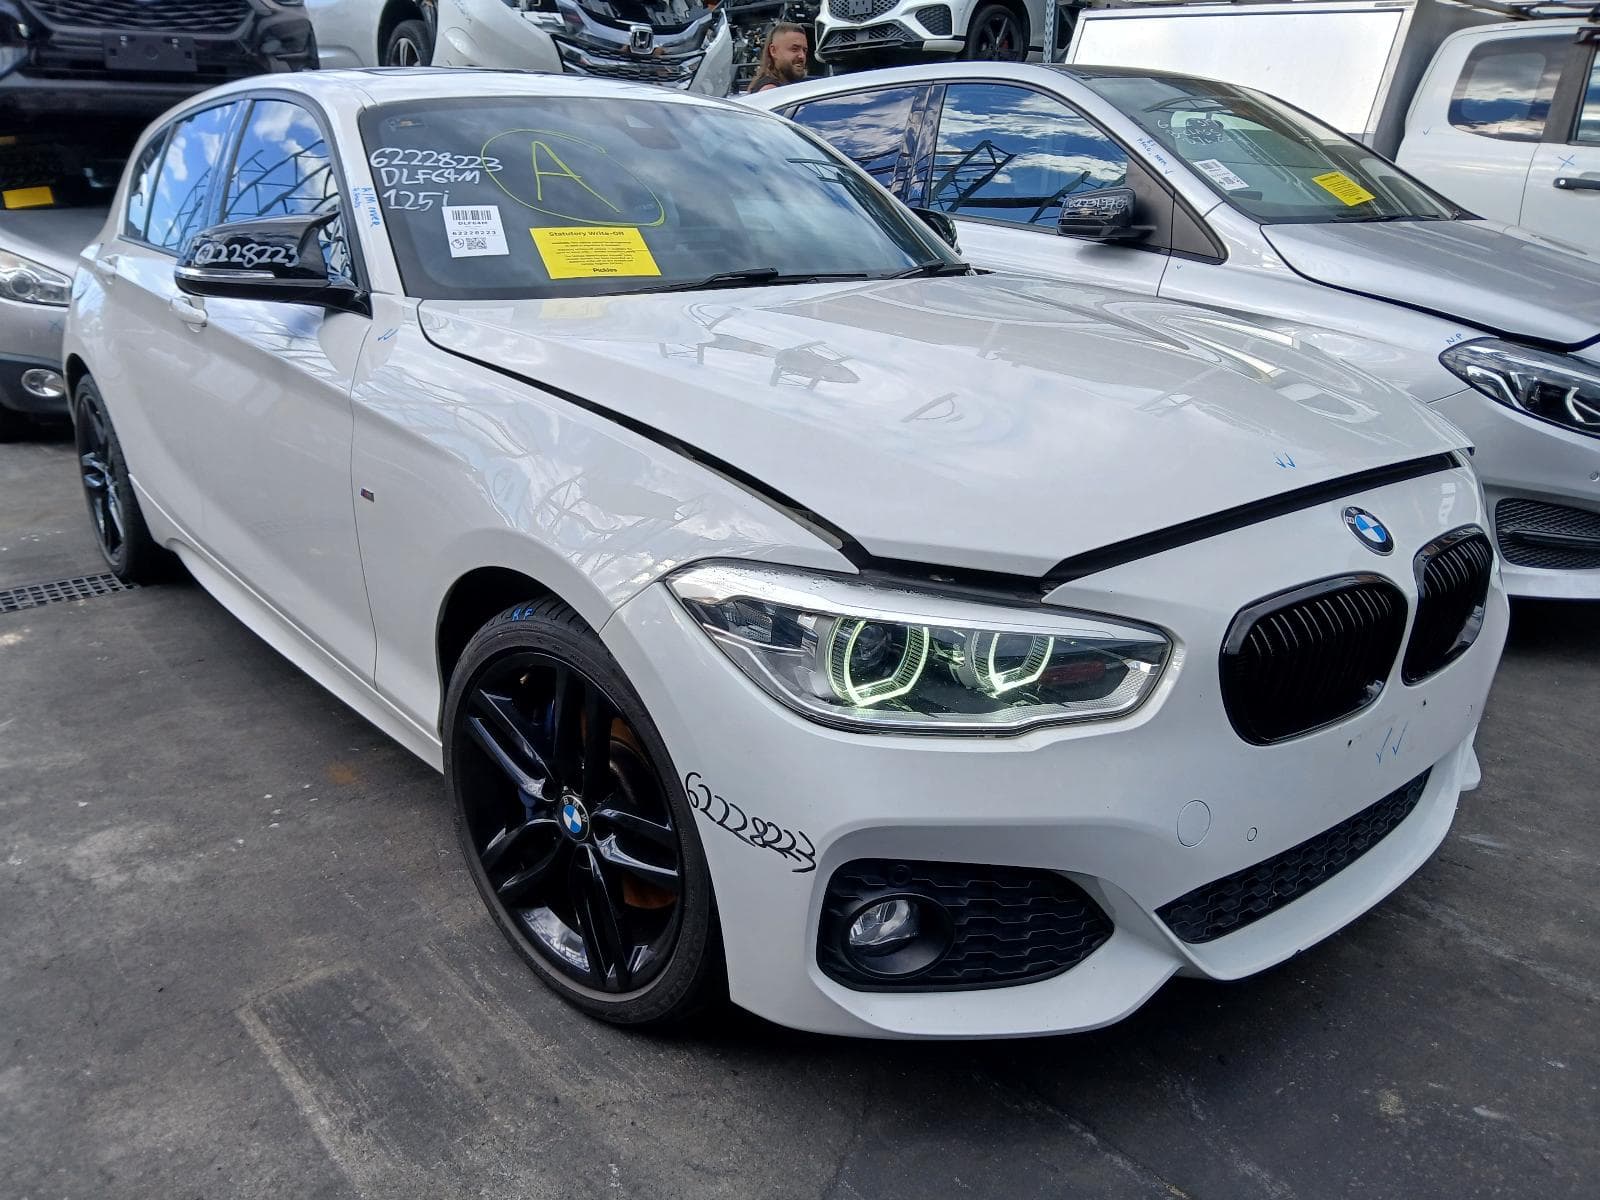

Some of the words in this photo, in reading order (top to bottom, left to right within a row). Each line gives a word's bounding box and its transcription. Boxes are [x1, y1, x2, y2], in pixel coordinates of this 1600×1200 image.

[369, 147, 503, 172] 62228223
[380, 167, 480, 186] DLF64M
[531, 140, 623, 213] A
[382, 188, 450, 211] 125i
[563, 797, 588, 823] BMW
[685, 771, 816, 873] 62228223
